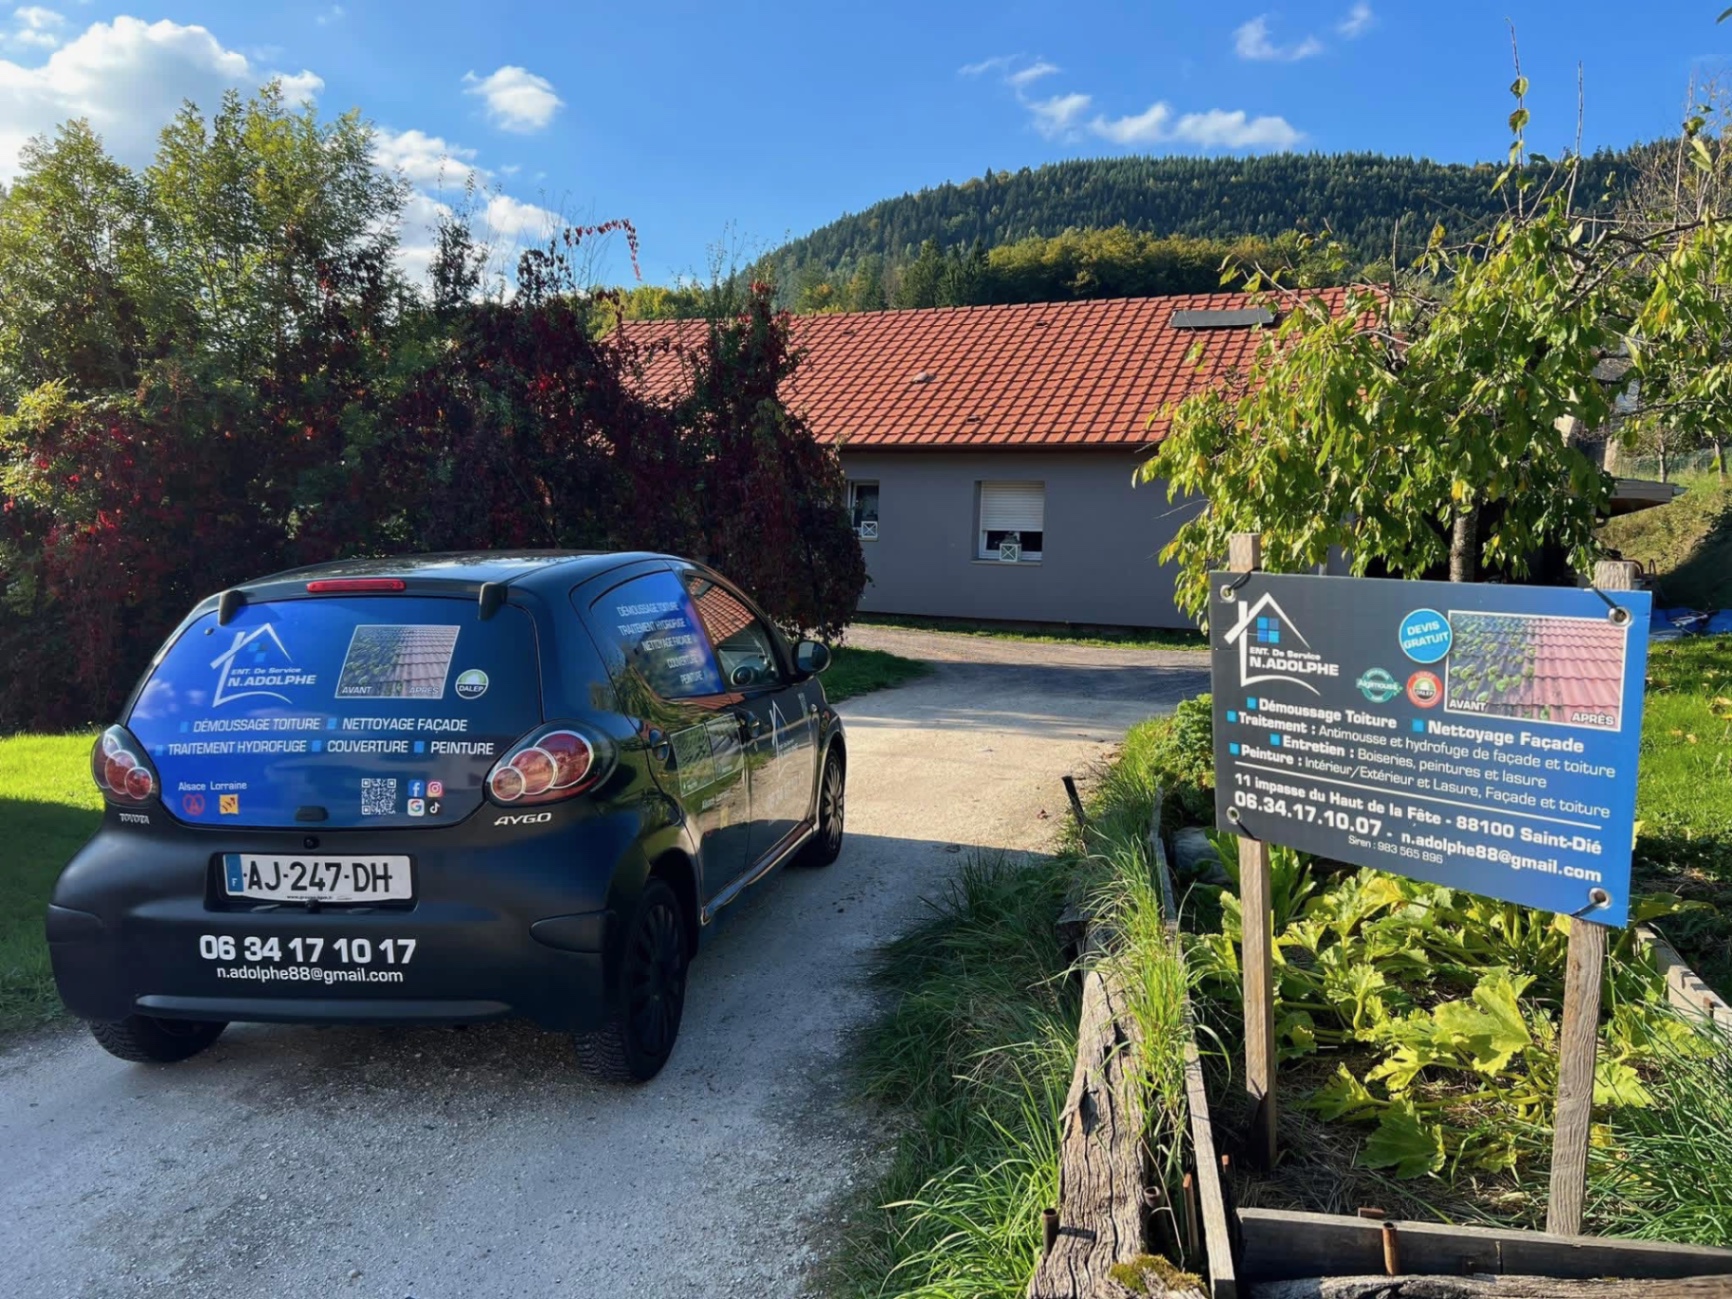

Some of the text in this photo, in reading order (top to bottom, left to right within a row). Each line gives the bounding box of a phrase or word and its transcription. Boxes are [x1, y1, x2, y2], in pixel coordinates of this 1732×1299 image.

[1407, 620, 1440, 636] DEVIS
[1403, 631, 1449, 650] GRATUIT
[1250, 646, 1322, 661] ENT. De Service
[231, 668, 251, 676] ENT.
[254, 667, 266, 675] De
[1250, 656, 1340, 676] N.ADOLPHE
[227, 674, 317, 687] N.ADOLPHE
[342, 686, 373, 694] AVANT
[1258, 697, 1397, 729] Démoussage Toiture
[1449, 699, 1487, 711] AVANT
[193, 718, 322, 733] DÉMOUSSAGE TOITURE
[342, 717, 468, 734] NETTOYAGE FAÇADE
[1572, 711, 1615, 726] APRÈS
[1428, 720, 1584, 753] Nettoyage Façade
[168, 740, 307, 756] TRAITEMENT HYDROFUGE
[327, 740, 410, 753] COUVERTURE
[430, 741, 495, 755] PEINTURE
[1238, 711, 1308, 734] Traitement
[1319, 725, 1387, 746] Antimousse
[1390, 736, 1403, 748] et
[1405, 737, 1469, 760] hydrofuge
[1472, 746, 1490, 761] de
[1493, 749, 1541, 770] façade
[1545, 759, 1561, 771] et
[1563, 760, 1616, 779] toiture
[1282, 735, 1345, 757] Entretien
[1358, 748, 1417, 770] Boiseries,
[1419, 760, 1481, 779] peintures
[1484, 768, 1499, 781] et
[1502, 768, 1547, 788] lasure
[178, 781, 248, 791] Alsace Lorraine
[1241, 744, 1294, 765] Peinture
[1305, 756, 1415, 786] Intérieur/Extérieur
[1417, 776, 1430, 789] et
[1433, 777, 1482, 799] Lasure,
[1485, 786, 1537, 807] Façade
[1540, 797, 1556, 810] et
[1559, 799, 1611, 819] toiture
[119, 813, 150, 825] TOYOTA
[494, 812, 552, 826] AYGO
[1235, 773, 1251, 787] 11
[1255, 776, 1306, 798] impasse
[1309, 788, 1326, 802] du
[1329, 791, 1364, 810] Haut
[1367, 799, 1385, 814] de
[1389, 802, 1403, 818] la
[1407, 805, 1441, 825] Fête
[1456, 815, 1515, 839] 88100
[1520, 827, 1602, 855] Saint-Dié
[1234, 791, 1382, 838] 06.34.17.10.07
[1401, 831, 1602, 883] n.adolphe88@gmail.com
[1348, 834, 1372, 849] Siren
[1377, 841, 1398, 854] 983
[1400, 846, 1420, 860] 565
[1422, 851, 1443, 865] 896
[231, 878, 237, 887] F
[247, 860, 390, 893] AJ-247-DH
[199, 935, 417, 964] 06 34 17 10 17
[216, 965, 404, 985] n.adolphe88@gmail.com
